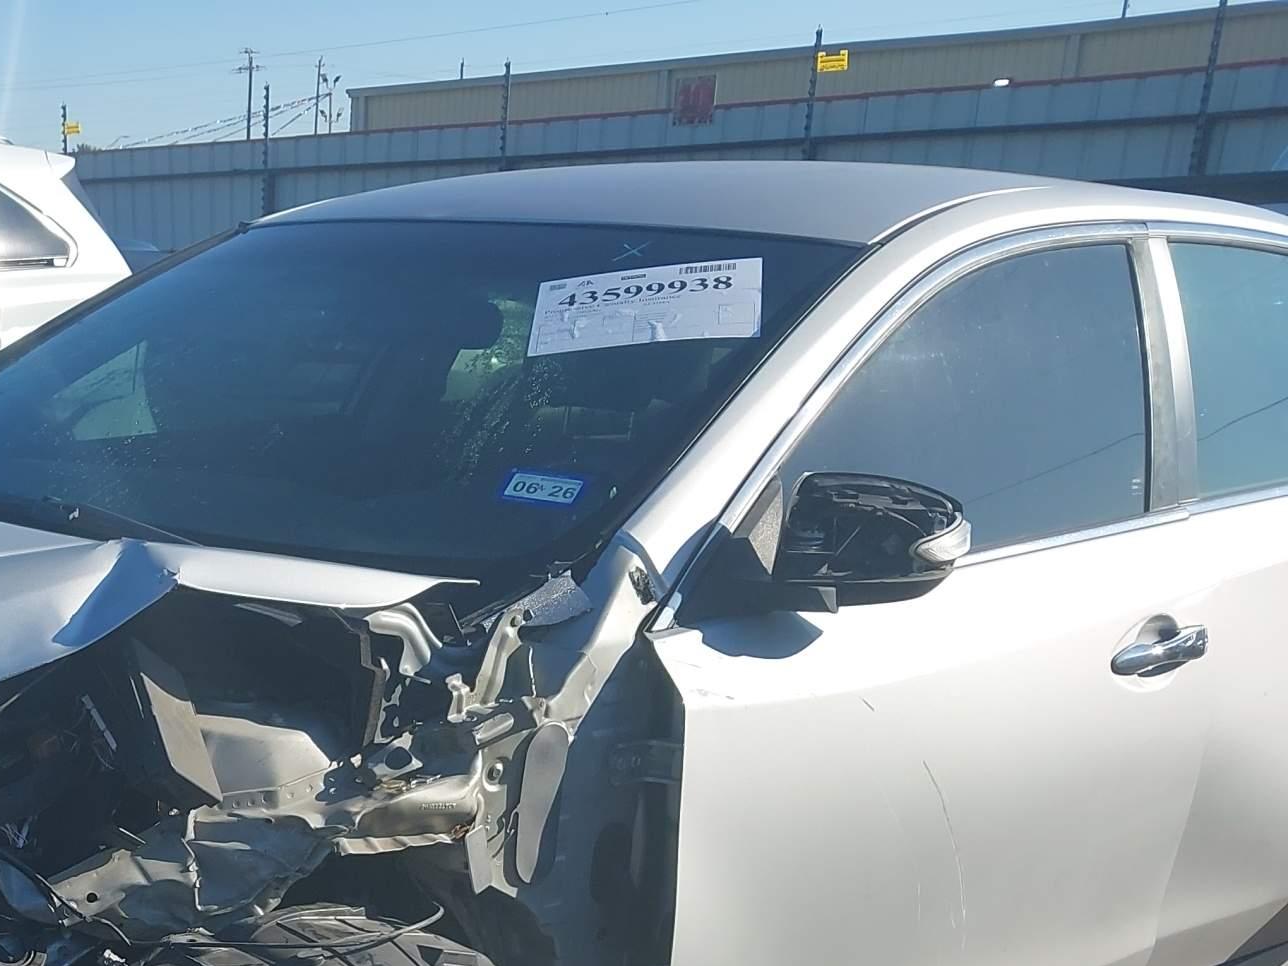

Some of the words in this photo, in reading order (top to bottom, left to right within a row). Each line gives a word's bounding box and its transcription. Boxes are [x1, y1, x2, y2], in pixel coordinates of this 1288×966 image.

[557, 275, 734, 308] 43599938
[513, 481, 538, 494] 06
[547, 485, 577, 500] 26
